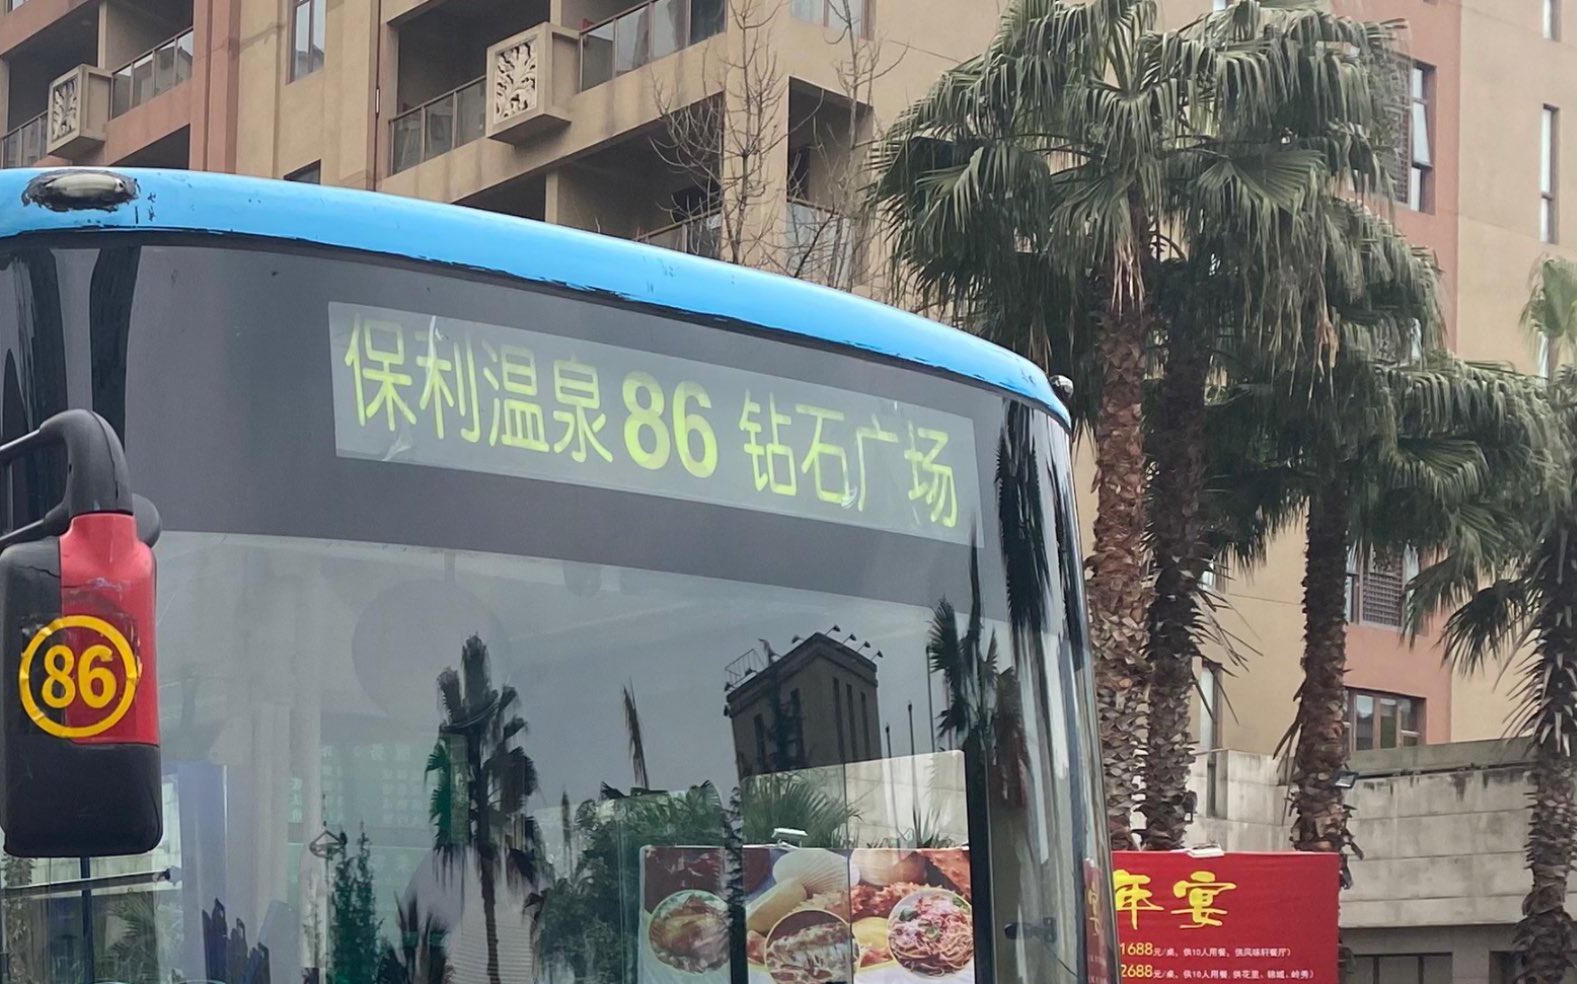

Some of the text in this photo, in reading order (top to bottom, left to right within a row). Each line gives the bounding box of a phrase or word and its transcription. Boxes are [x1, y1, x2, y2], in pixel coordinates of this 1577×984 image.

[343, 311, 958, 529] 保利温泉 86 钻石广场
[41, 644, 117, 709] 86
[1113, 869, 1237, 931] 年宴
